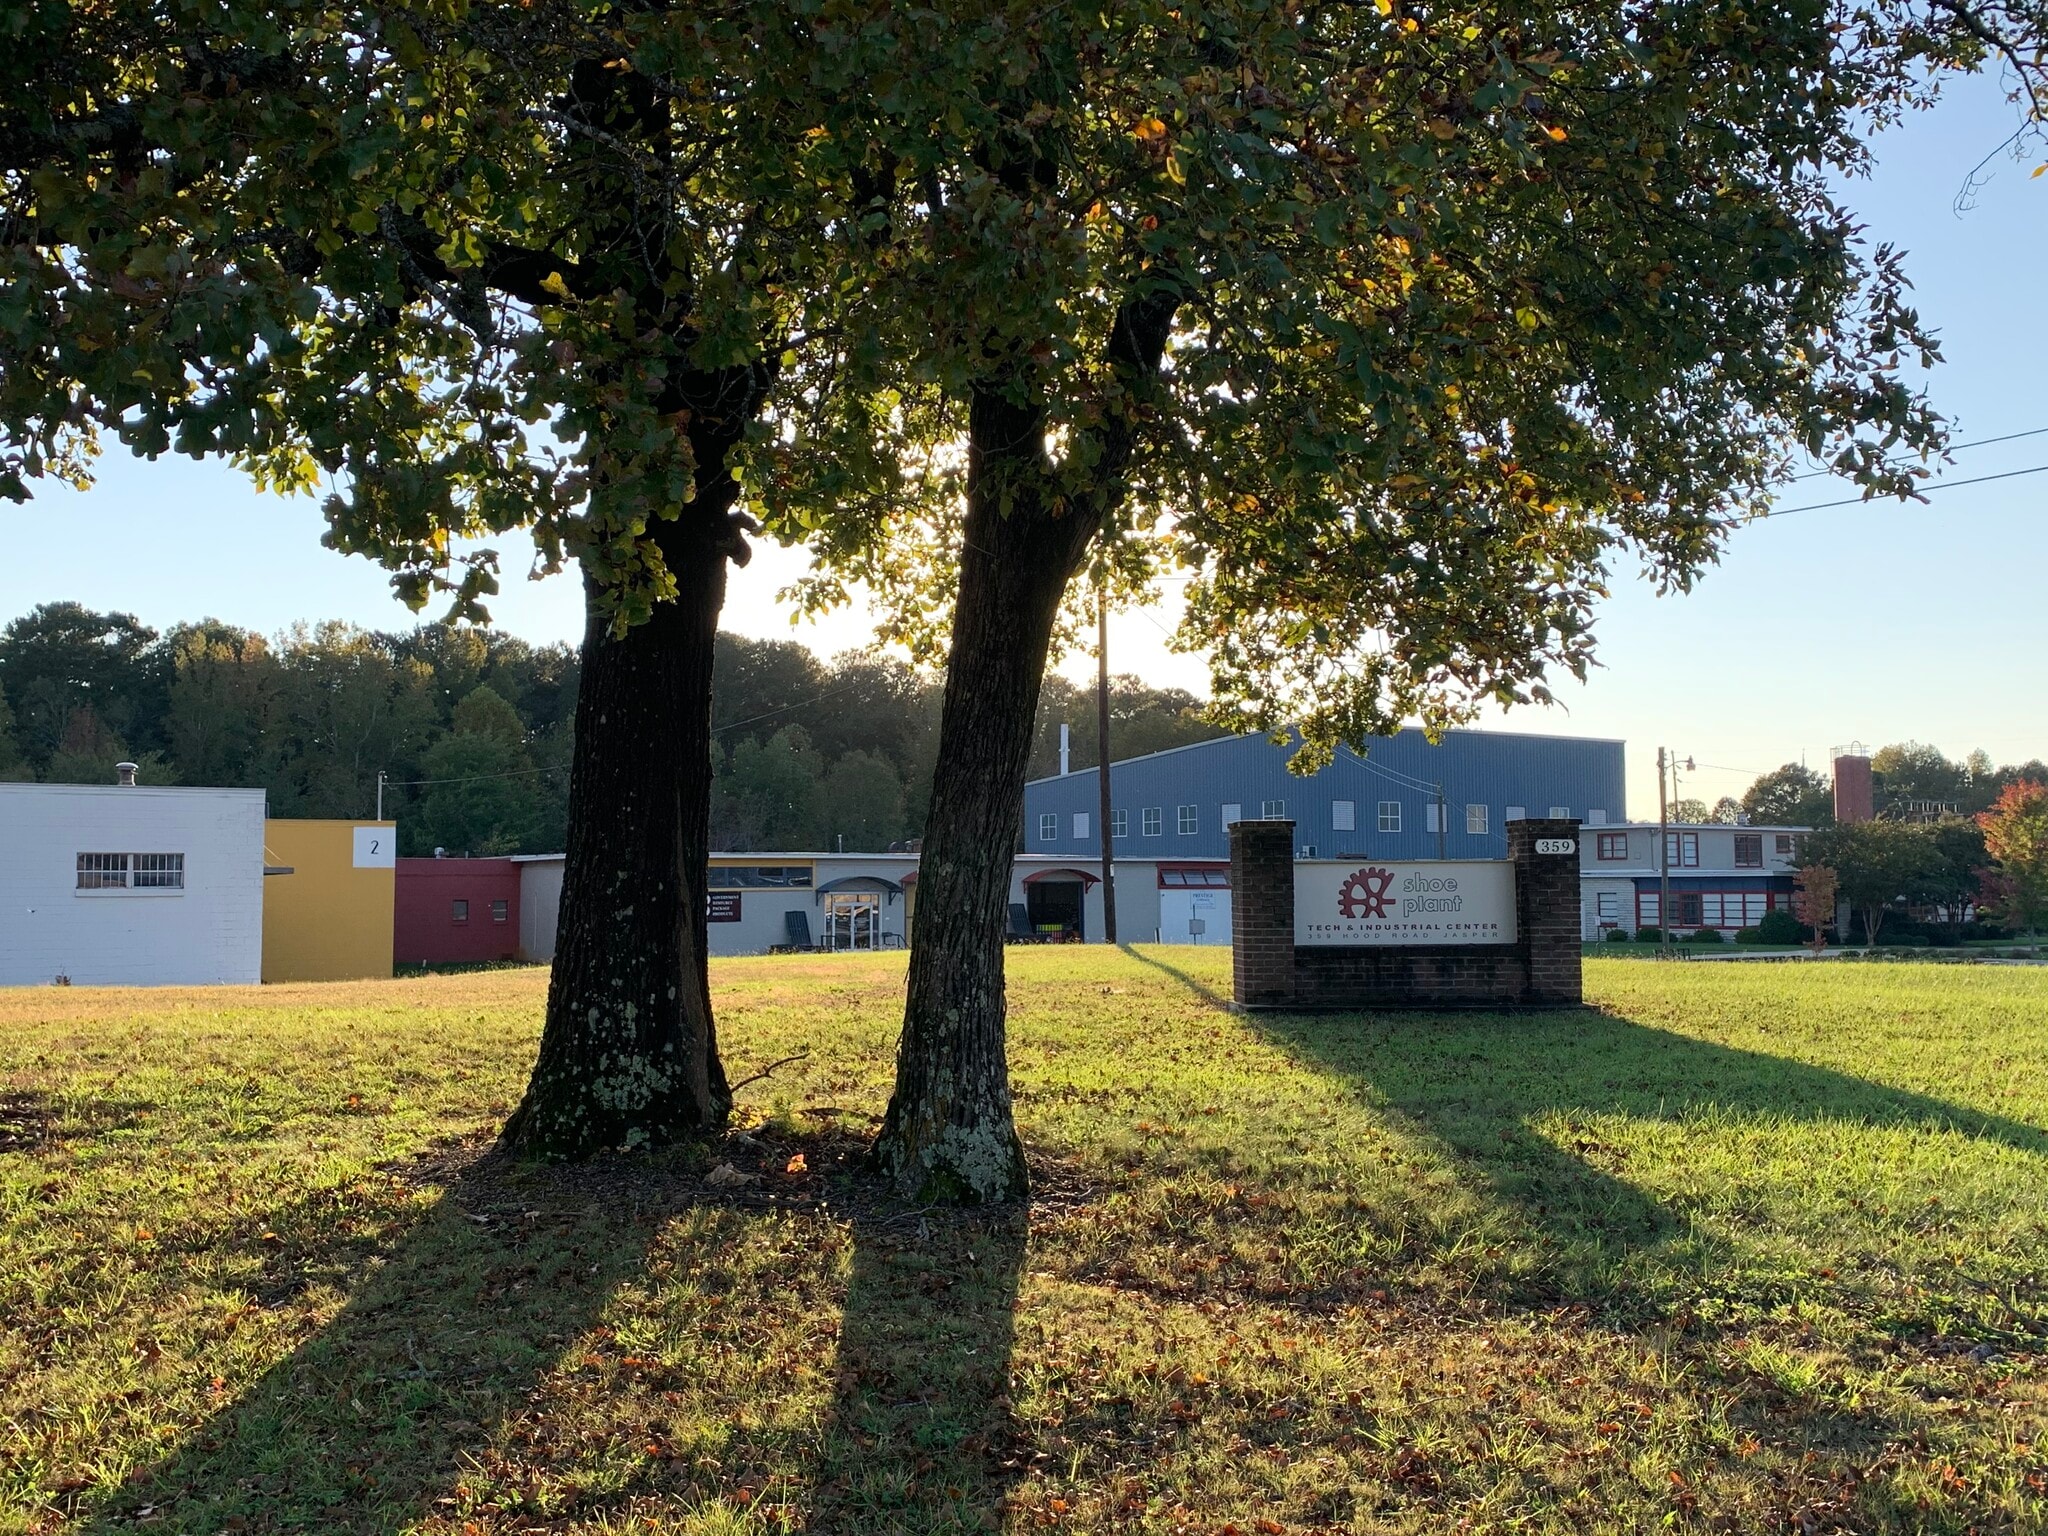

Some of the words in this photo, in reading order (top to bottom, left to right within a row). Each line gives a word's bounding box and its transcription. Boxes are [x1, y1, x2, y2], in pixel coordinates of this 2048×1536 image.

[370, 840, 379, 855] 2
[1541, 841, 1570, 853] 359
[1403, 872, 1458, 893] shoe
[1403, 895, 1463, 918] plant
[1307, 924, 1341, 932] TECH
[1360, 923, 1441, 931] INDUSTRIAL
[1446, 923, 1499, 931] CENTER
